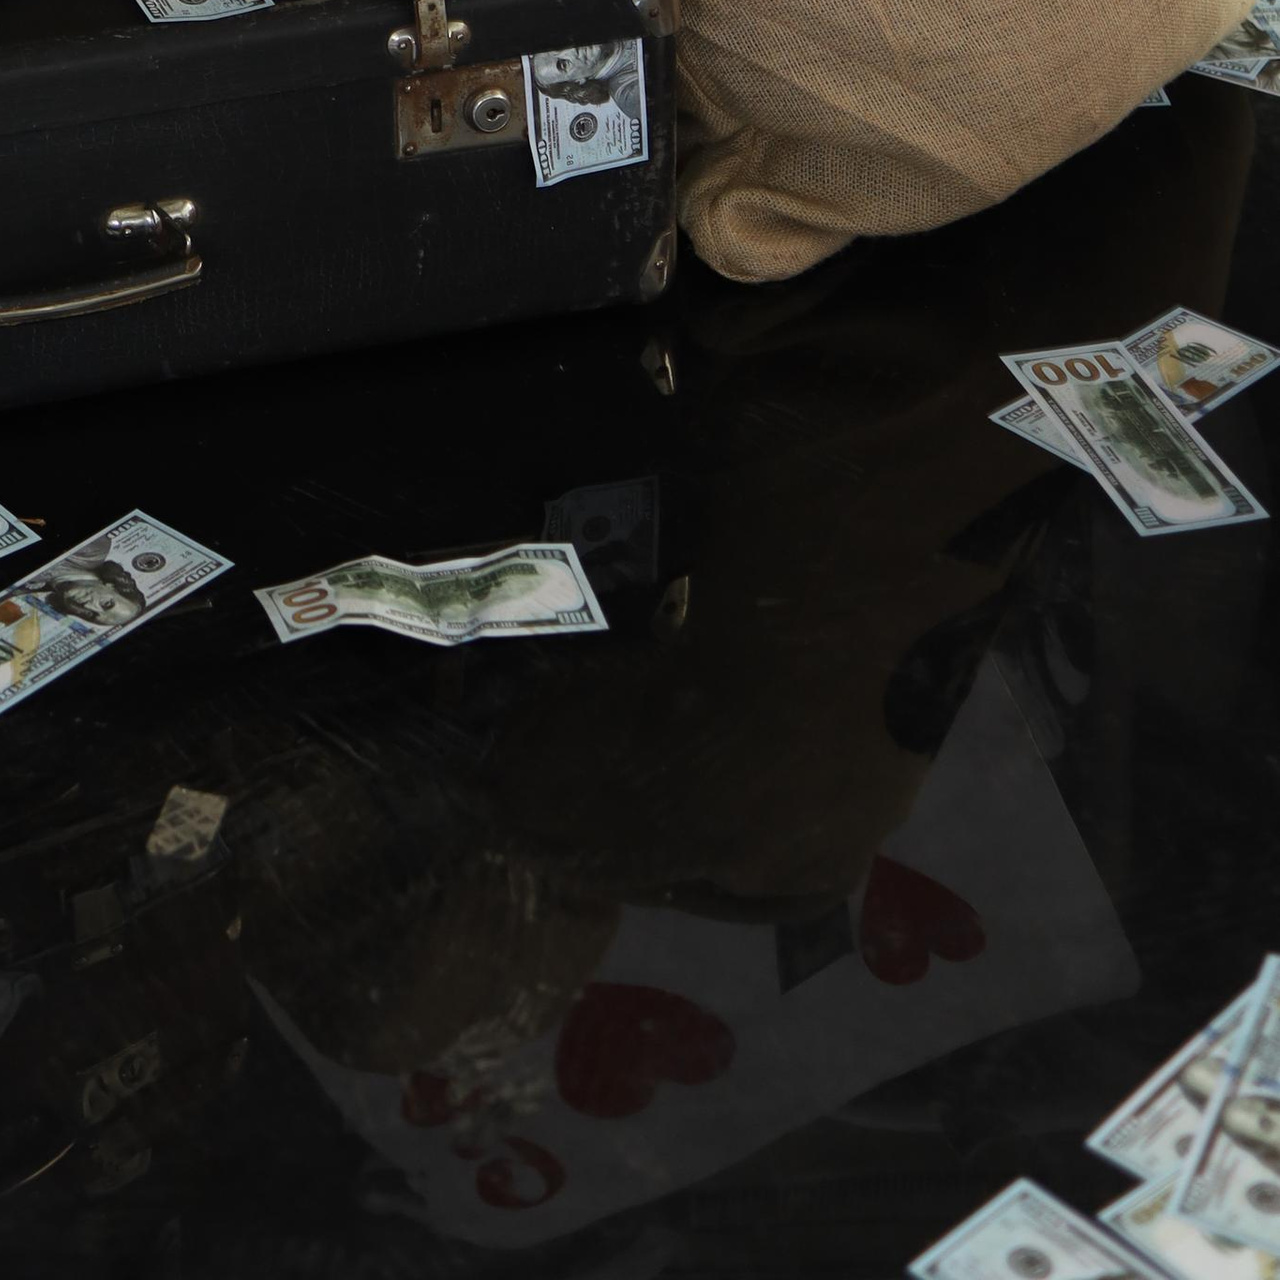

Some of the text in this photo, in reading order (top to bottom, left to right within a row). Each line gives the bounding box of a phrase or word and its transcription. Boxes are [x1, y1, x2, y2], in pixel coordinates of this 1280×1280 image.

[629, 117, 641, 151] 100
[537, 138, 550, 178] 100
[1031, 354, 1126, 386] 100
